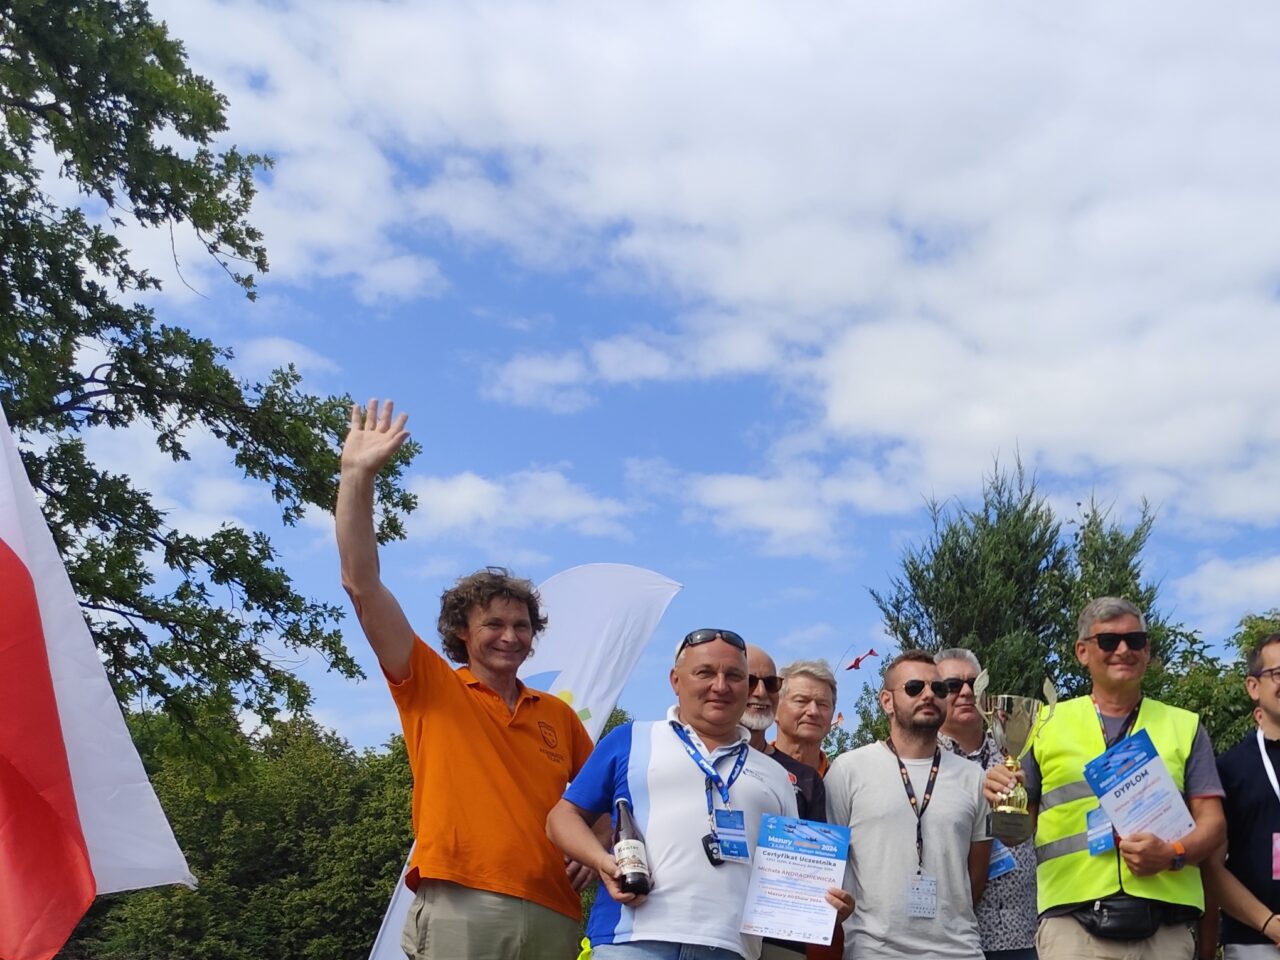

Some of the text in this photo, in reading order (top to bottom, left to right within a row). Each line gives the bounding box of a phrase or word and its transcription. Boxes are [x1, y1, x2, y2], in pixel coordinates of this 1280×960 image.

[1113, 769, 1149, 799] DYPLOM
[768, 835, 793, 846] Mazury
[821, 844, 838, 853] 2024
[762, 850, 798, 861] Certyfikat
[799, 855, 837, 867] Uczestnika
